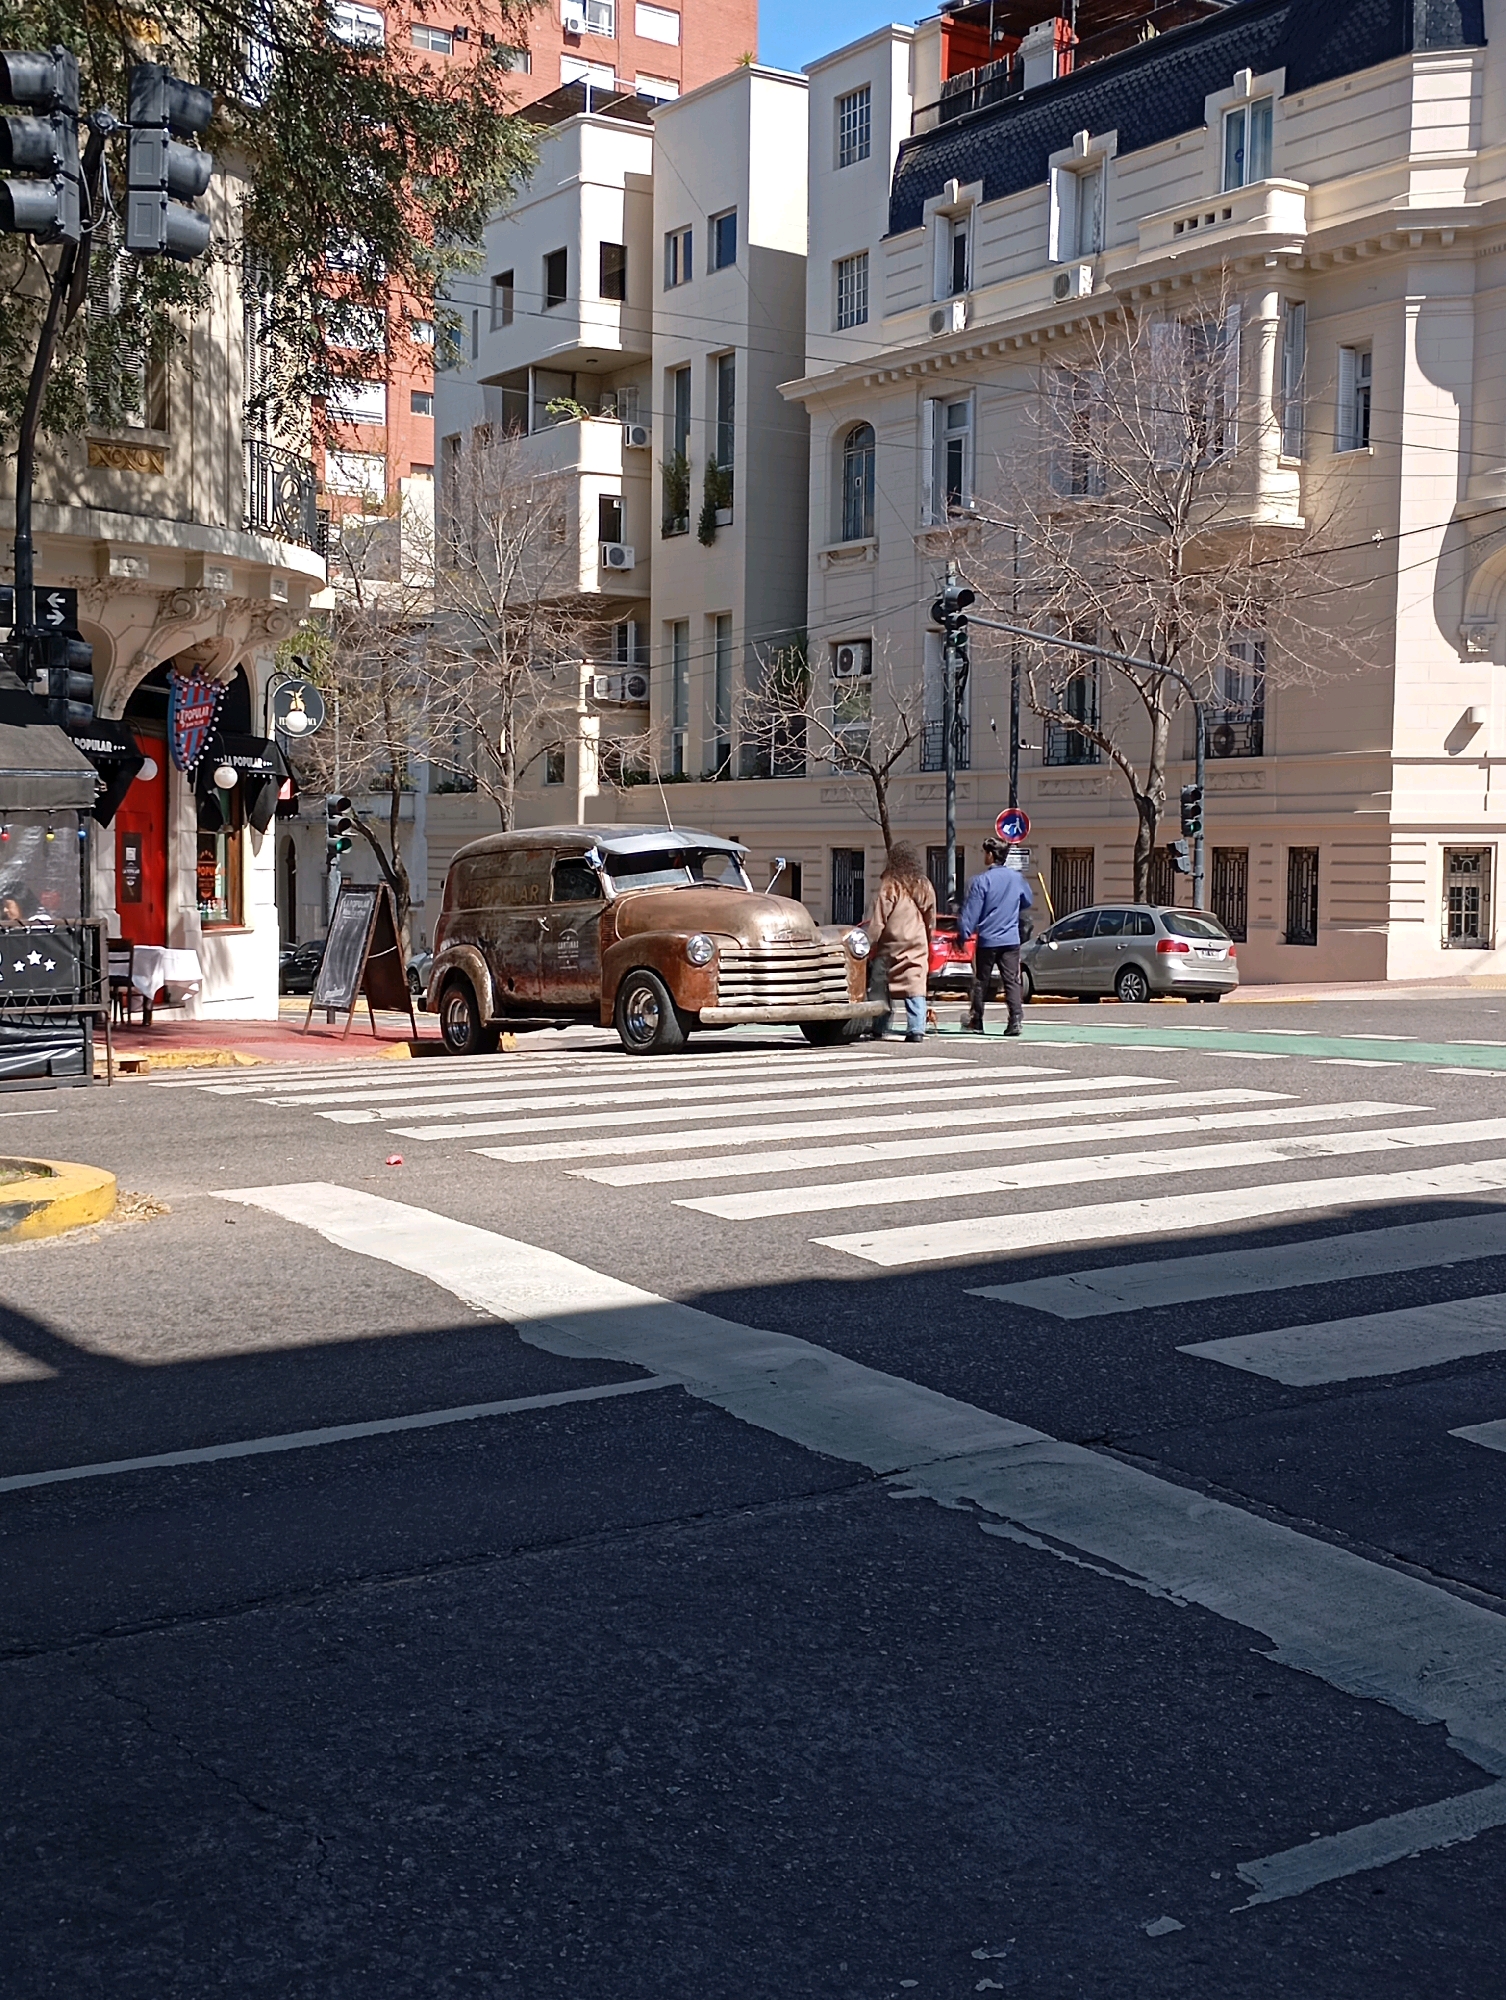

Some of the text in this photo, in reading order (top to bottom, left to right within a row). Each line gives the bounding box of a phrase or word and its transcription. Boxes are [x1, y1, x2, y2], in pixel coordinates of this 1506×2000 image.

[184, 705, 210, 722] POPULAR
[233, 756, 263, 769] POPULAR
[475, 884, 540, 905] POPULAR
